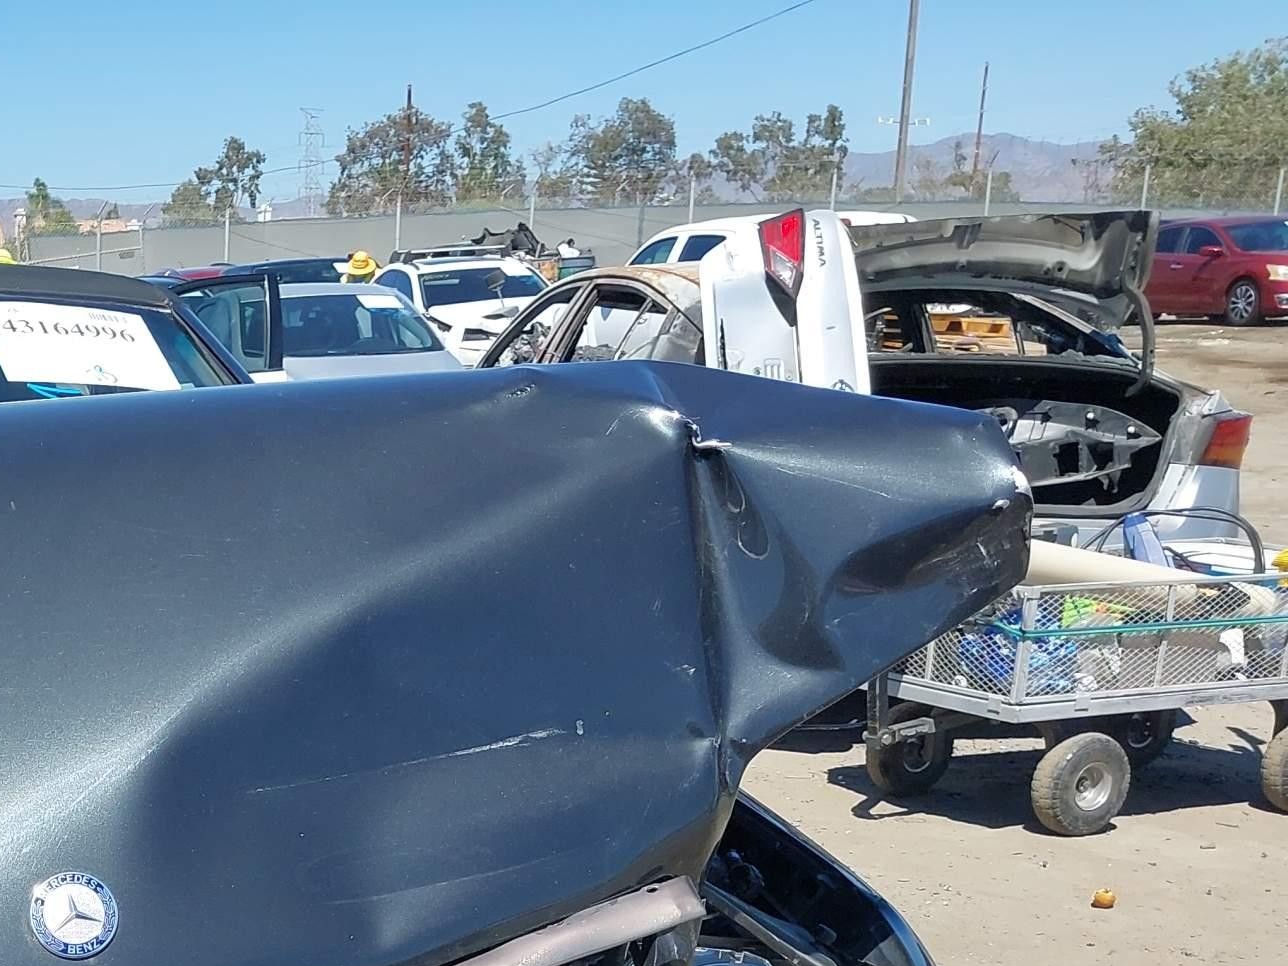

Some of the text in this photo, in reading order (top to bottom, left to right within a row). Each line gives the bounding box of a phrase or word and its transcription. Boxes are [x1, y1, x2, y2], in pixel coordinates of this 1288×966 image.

[811, 218, 827, 268] ALTIMA
[2, 319, 136, 343] 43164996
[67, 938, 100, 955] BENZ
